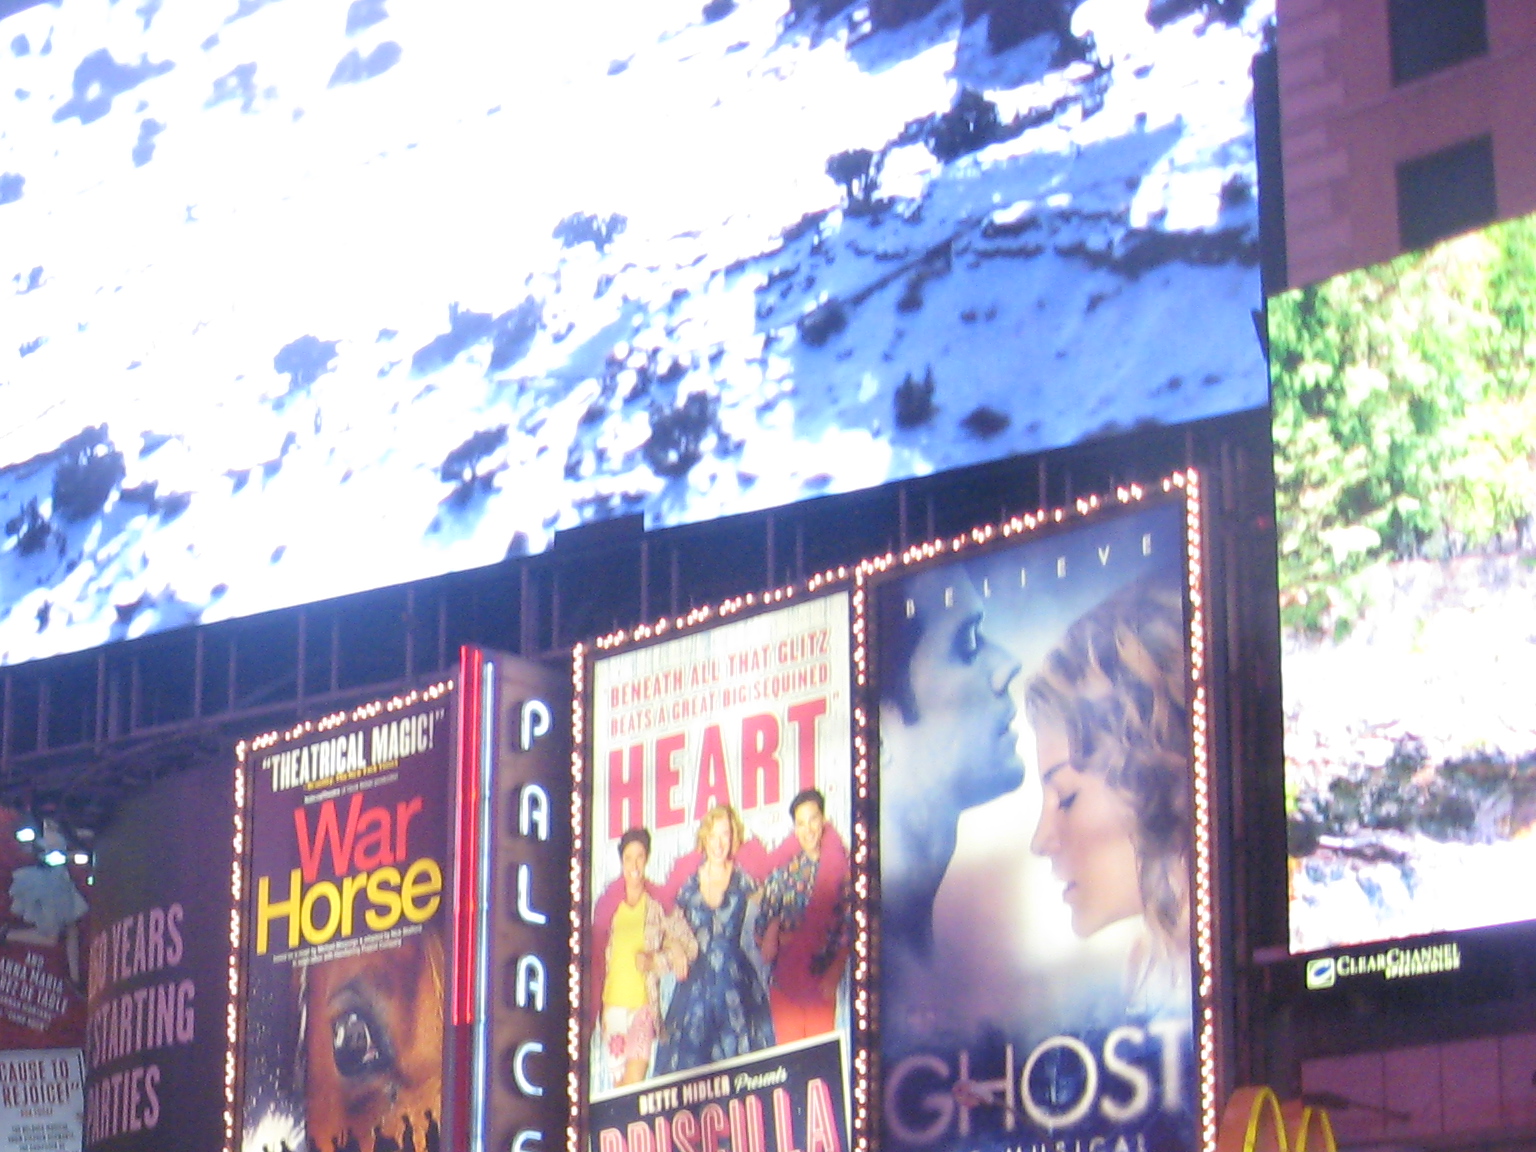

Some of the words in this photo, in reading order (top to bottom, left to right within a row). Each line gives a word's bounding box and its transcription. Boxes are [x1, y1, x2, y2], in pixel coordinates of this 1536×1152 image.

[611, 669, 683, 708] BENEATH
[691, 660, 720, 686] ALL
[728, 645, 771, 677] THAT
[778, 628, 830, 664] GLITZ
[611, 707, 652, 737] BEATS
[657, 705, 666, 723] A
[672, 692, 716, 720] GREAT
[723, 686, 747, 709] BIG
[753, 663, 829, 700] SEQUINED
[294, 793, 424, 883] War
[113, 902, 184, 983] YEARS
[257, 857, 443, 956] Horse
[88, 978, 196, 1069] STARTING
[52, 1059, 70, 1080] TO
[639, 1090, 678, 1115] BETTE
[683, 1075, 730, 1105] MIDLER
[734, 1066, 788, 1094] Presents
[884, 1019, 1191, 1144] GHOST
